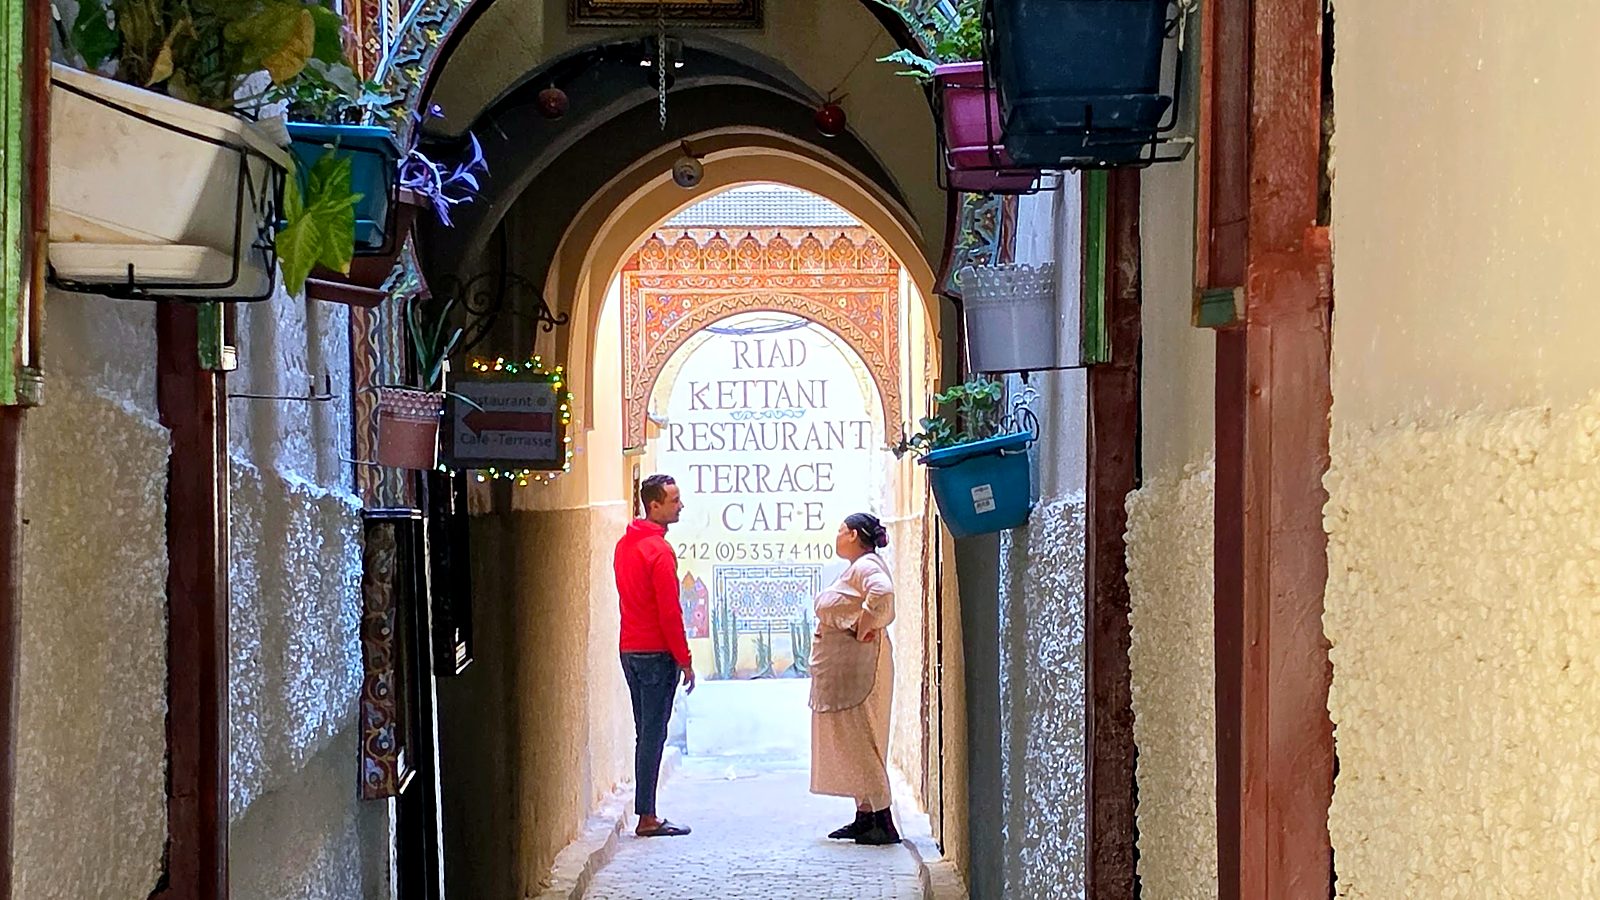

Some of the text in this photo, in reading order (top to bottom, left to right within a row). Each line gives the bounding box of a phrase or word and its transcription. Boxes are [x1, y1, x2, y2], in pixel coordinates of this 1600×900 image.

[731, 338, 807, 369] RIAD
[688, 379, 829, 411] KETTANI
[667, 420, 872, 452] RESTAURANT
[689, 462, 835, 494] TERRACE
[722, 502, 826, 531] CAFE
